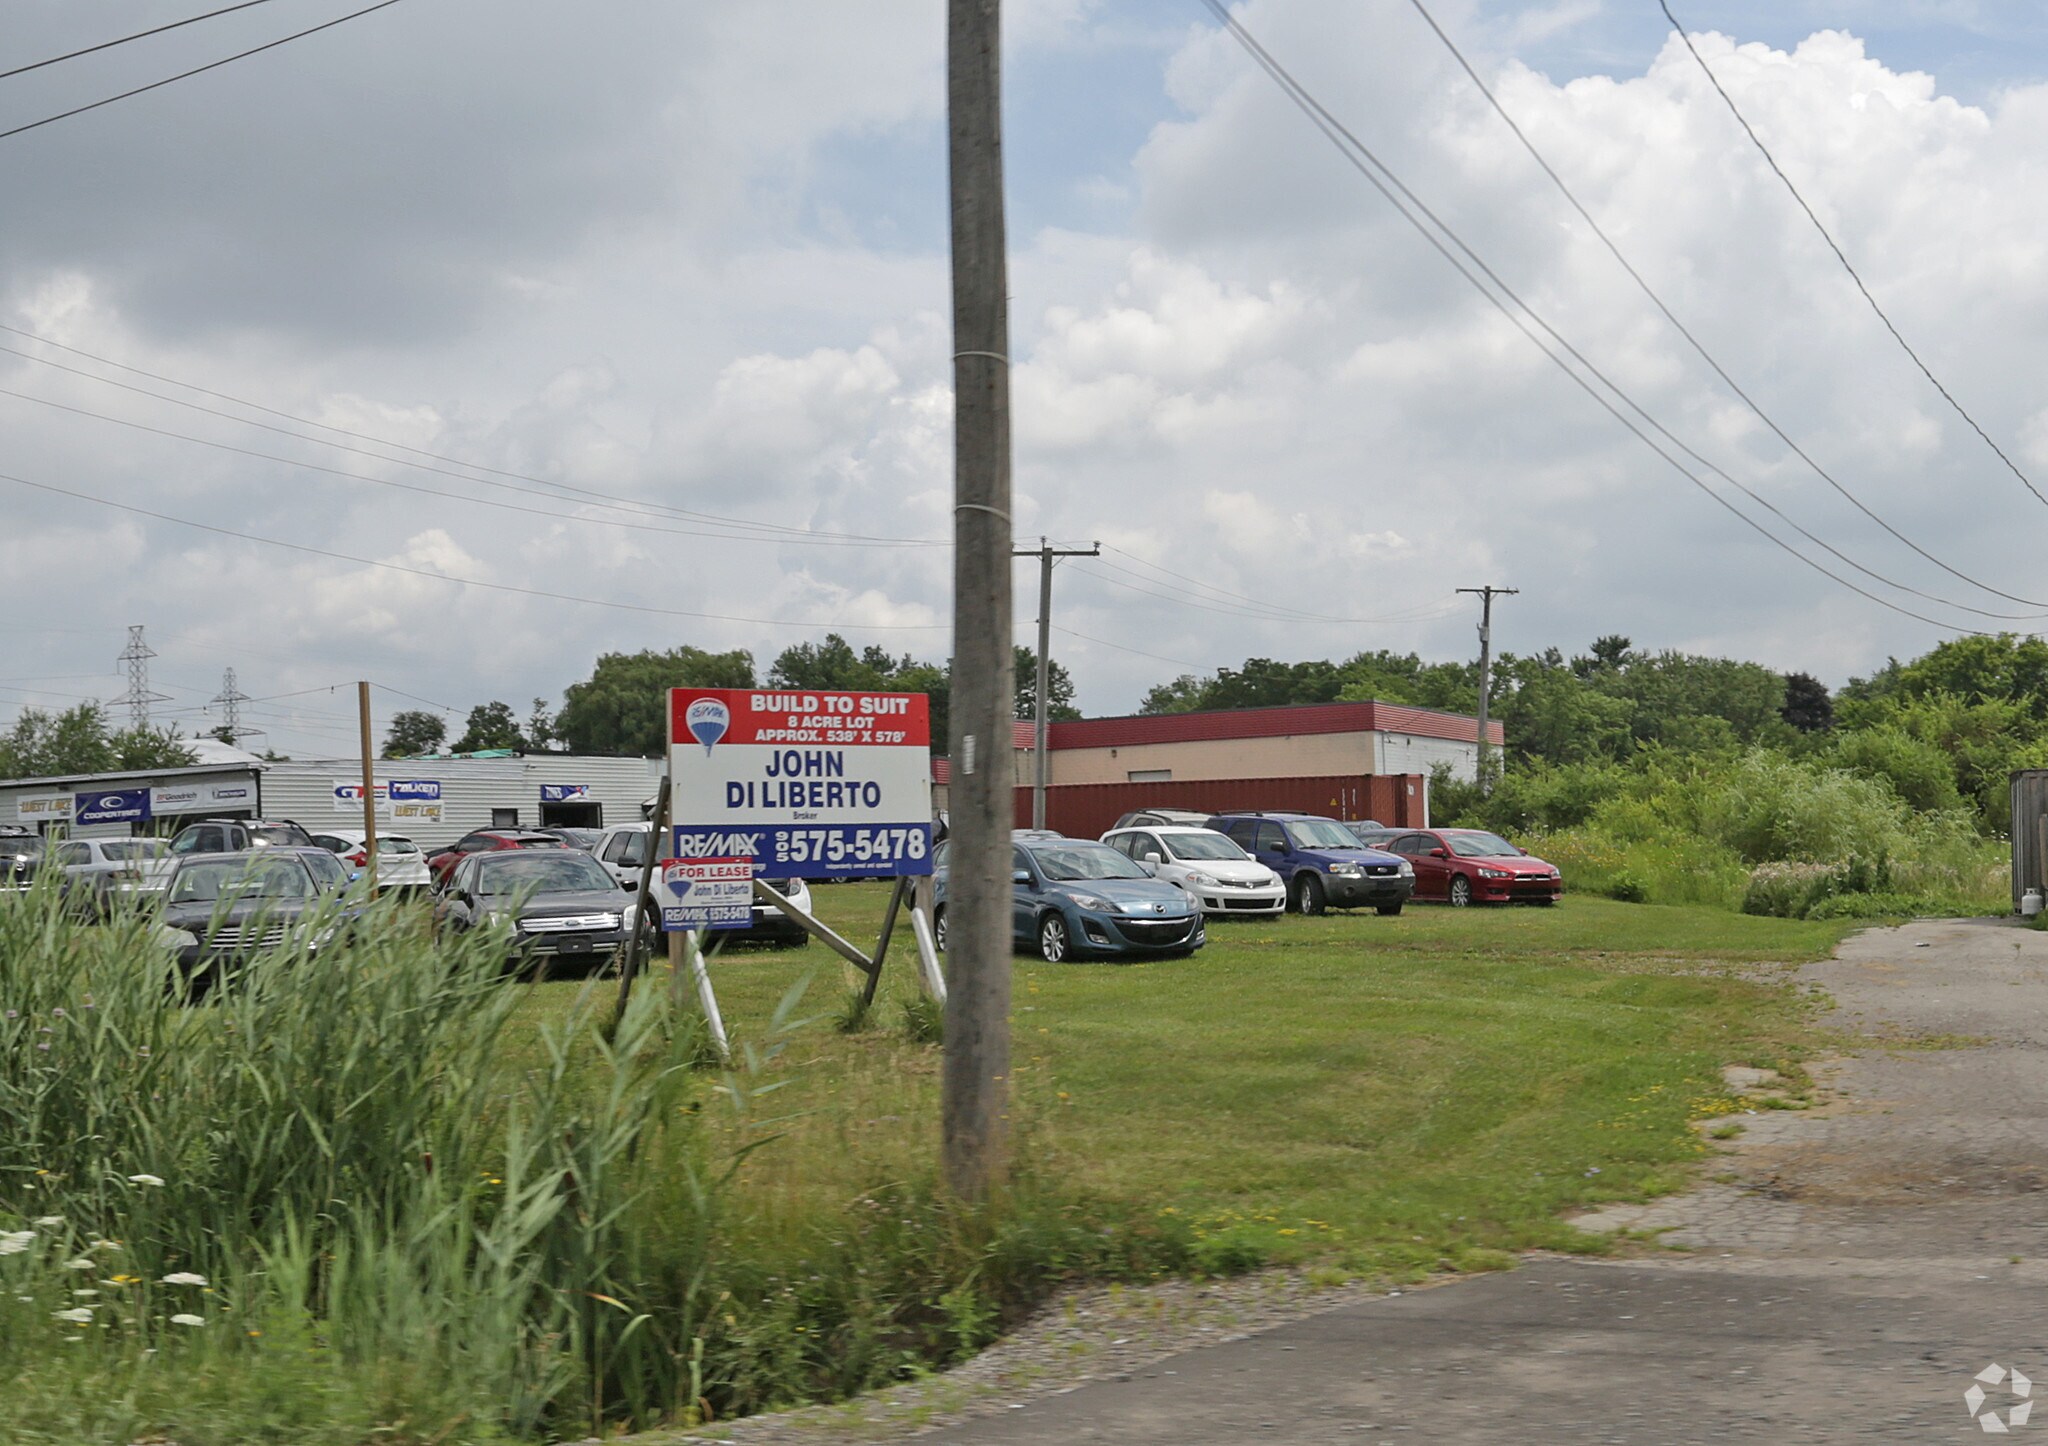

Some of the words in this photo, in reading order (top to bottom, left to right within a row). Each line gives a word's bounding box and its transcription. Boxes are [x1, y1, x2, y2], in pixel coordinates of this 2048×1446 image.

[751, 694, 819, 712] BUILD
[823, 696, 854, 713] TO
[859, 697, 909, 714] SUIT
[787, 715, 798, 728] 8
[801, 716, 842, 728] ACRE
[846, 716, 875, 729] LOT
[755, 729, 823, 742] APPROX.
[861, 731, 872, 743] X
[765, 749, 844, 778] JOHN
[726, 781, 755, 808] DI
[762, 780, 881, 808] LIBERTO
[793, 811, 818, 820] Broker
[680, 832, 760, 858] RE/MAX
[790, 828, 926, 862] 575-5478
[679, 867, 705, 878] FOR
[710, 866, 749, 877] LEASE
[694, 884, 712, 896] John
